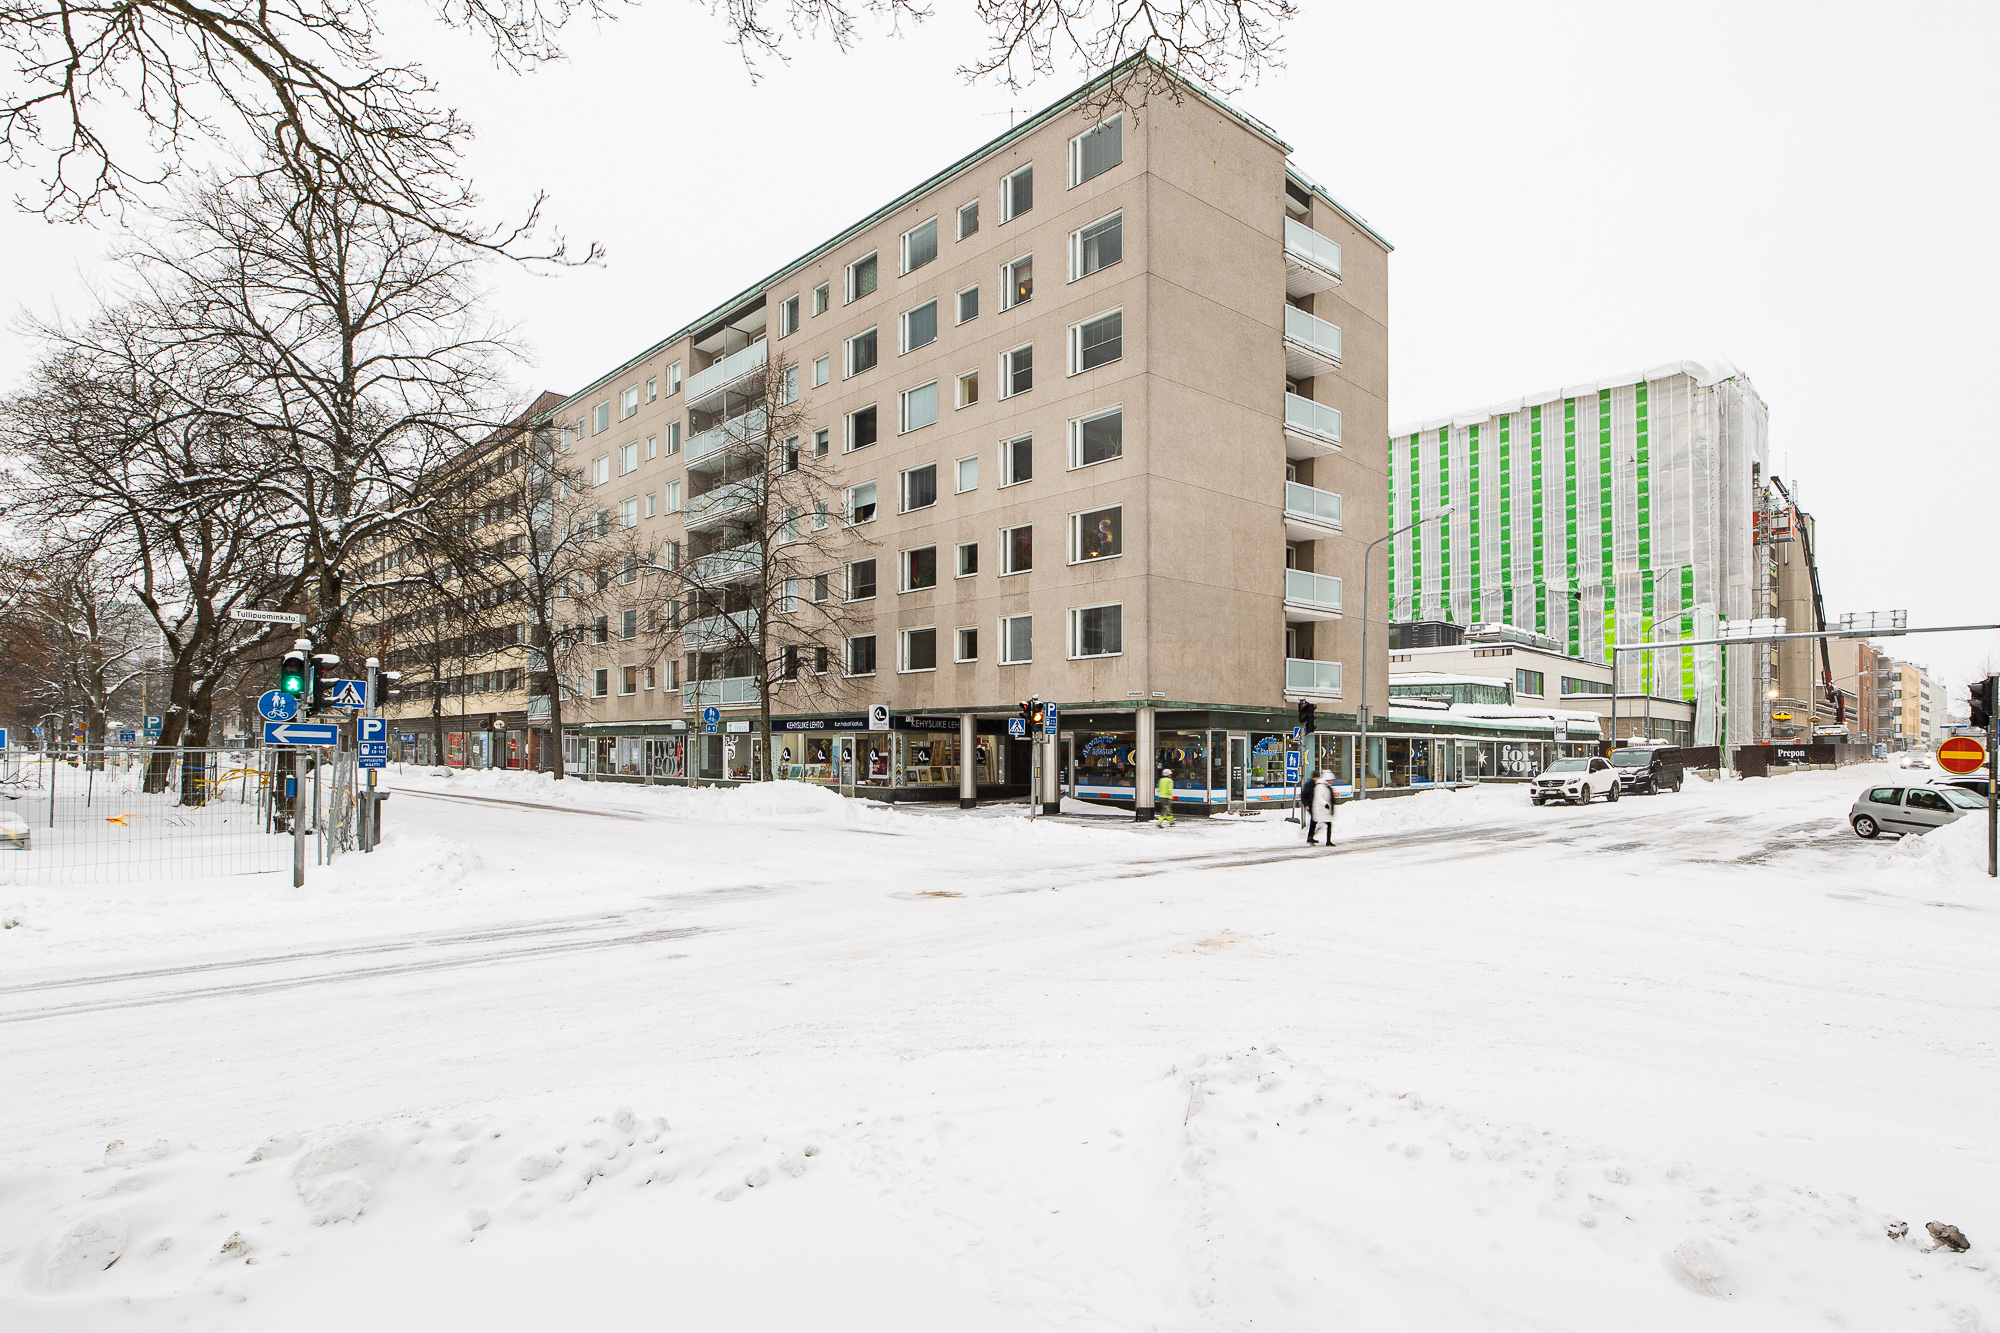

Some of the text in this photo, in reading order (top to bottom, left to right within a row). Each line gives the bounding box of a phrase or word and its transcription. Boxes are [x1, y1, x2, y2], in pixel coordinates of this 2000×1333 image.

[236, 610, 296, 622] Tullipuominkatu
[1047, 703, 1056, 717] P
[147, 716, 160, 729] P
[948, 720, 960, 729] LEH
[363, 719, 383, 740] P
[1502, 744, 1535, 761] for
[1777, 748, 1806, 759] Prepon
